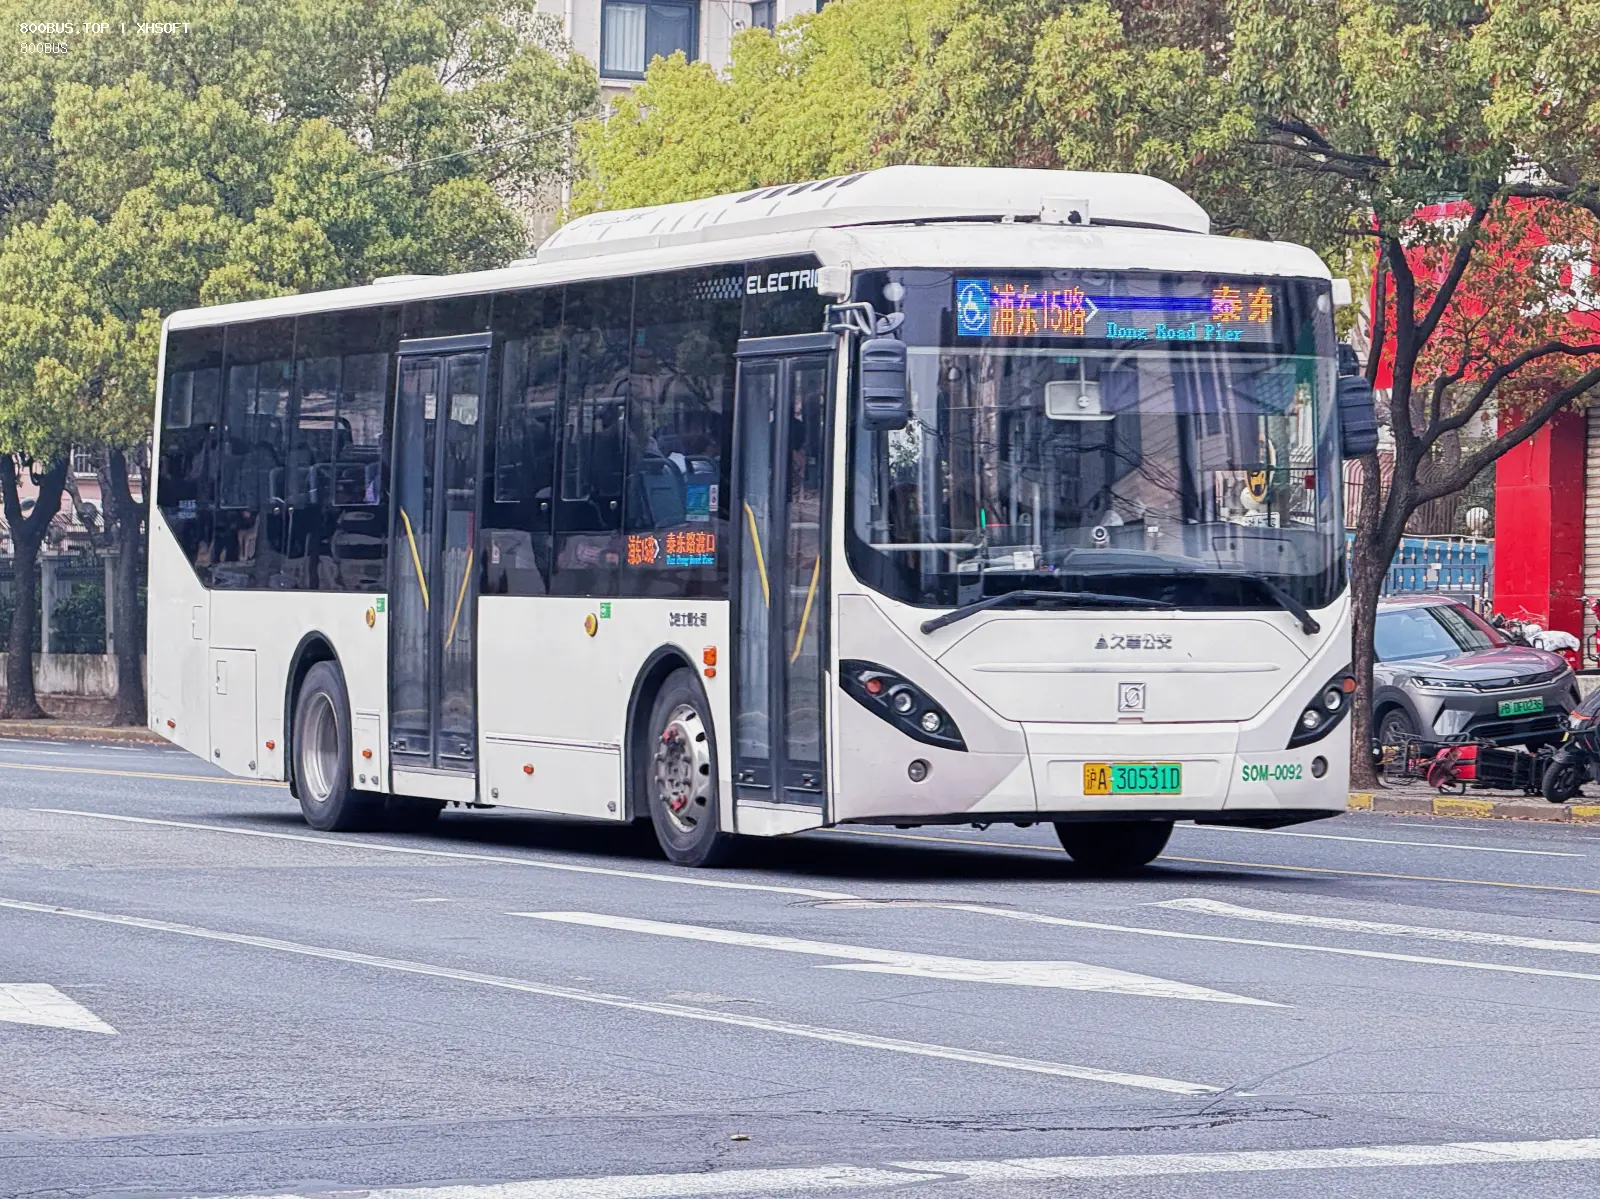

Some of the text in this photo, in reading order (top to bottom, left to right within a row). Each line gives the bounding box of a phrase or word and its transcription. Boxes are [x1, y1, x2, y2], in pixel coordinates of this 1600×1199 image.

[992, 283, 1086, 336] 浦东15路
[1211, 286, 1273, 323] 泰东
[1106, 321, 1244, 341] Dong Road Pier
[1116, 767, 1180, 791] 30531D
